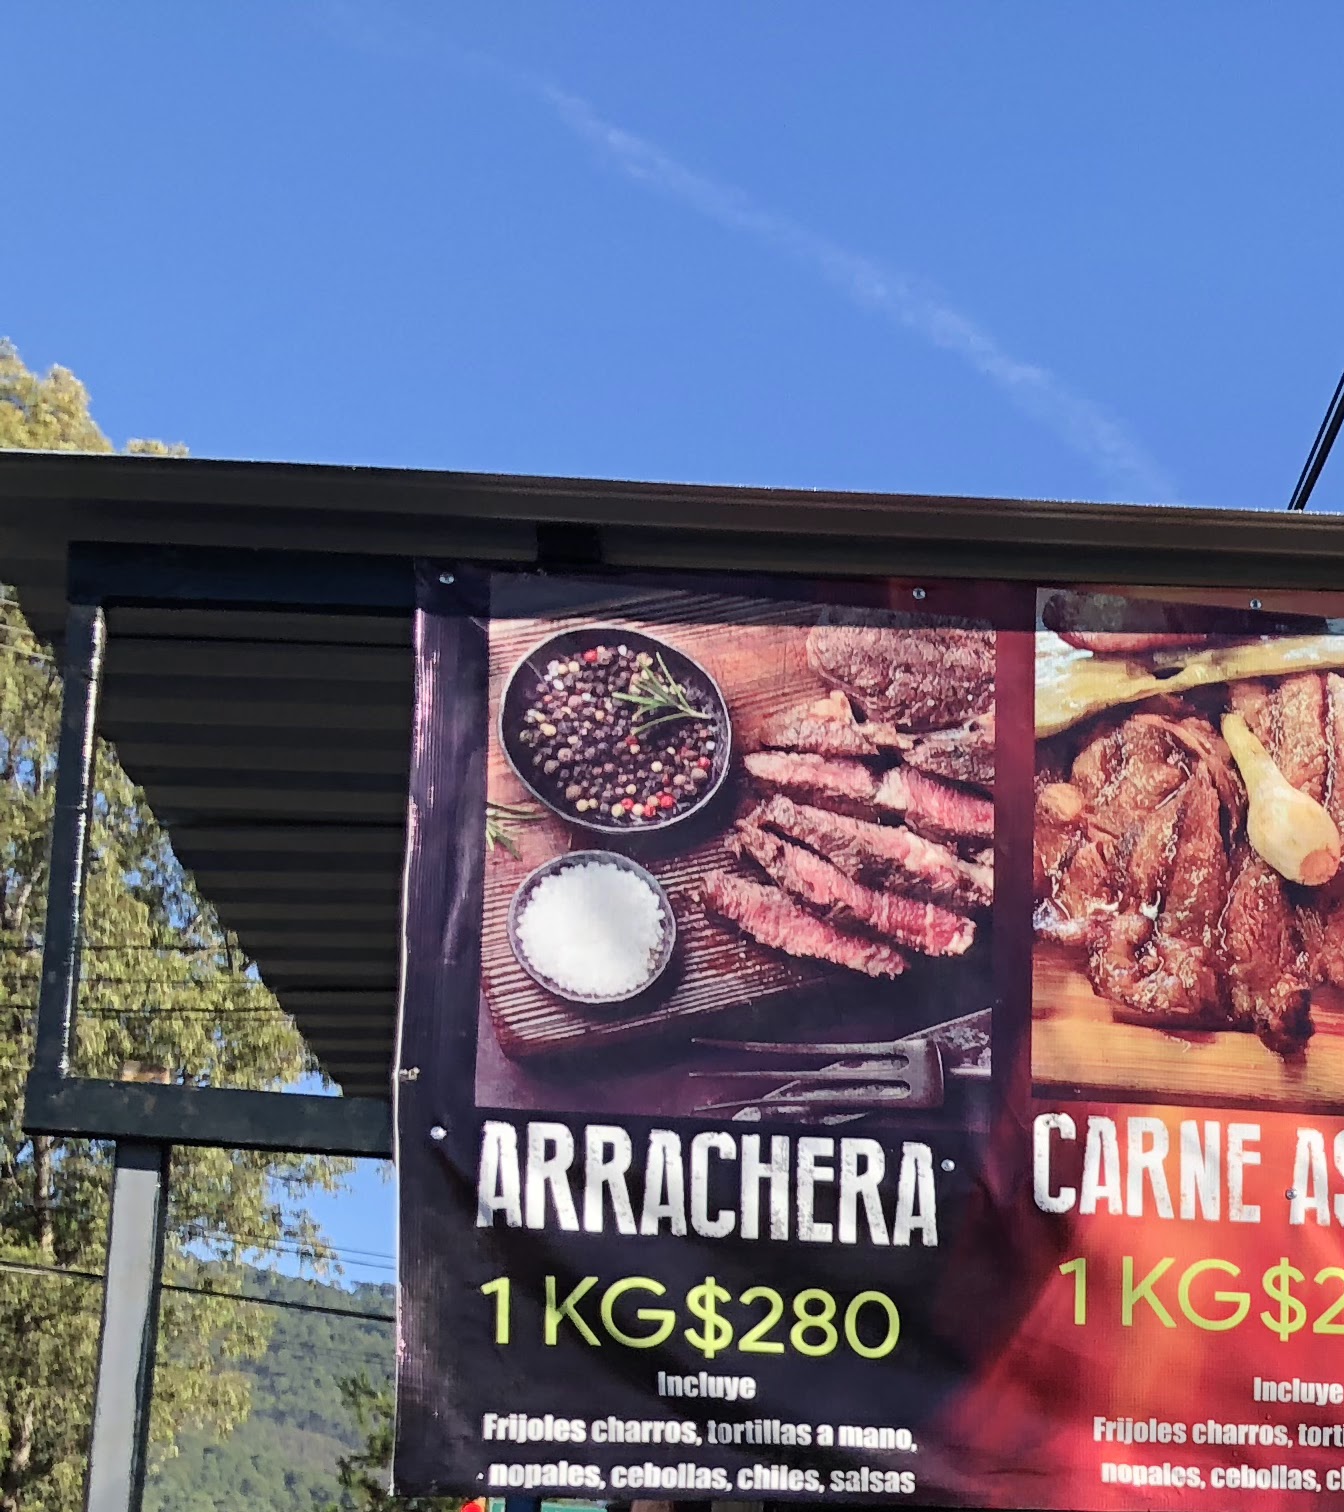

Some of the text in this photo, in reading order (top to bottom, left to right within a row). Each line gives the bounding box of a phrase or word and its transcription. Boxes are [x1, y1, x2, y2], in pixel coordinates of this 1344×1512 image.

[476, 1120, 938, 1247] ARRACHERA
[1033, 1113, 1261, 1223] CARNE
[1059, 1257, 1088, 1325] 1
[480, 1277, 511, 1344] 1
[658, 1371, 756, 1400] Incluye
[1253, 1377, 1344, 1405] Incluye
[483, 1413, 917, 1453] Frijoles charros, tortillas a mano,
[1093, 1416, 1186, 1445] Frijoles
[1193, 1420, 1293, 1448] charros,
[488, 1462, 915, 1493] nopales, cebollas, chiles, salsas
[1101, 1462, 1206, 1490] nopales,
[1210, 1464, 1321, 1492] cebollas,
